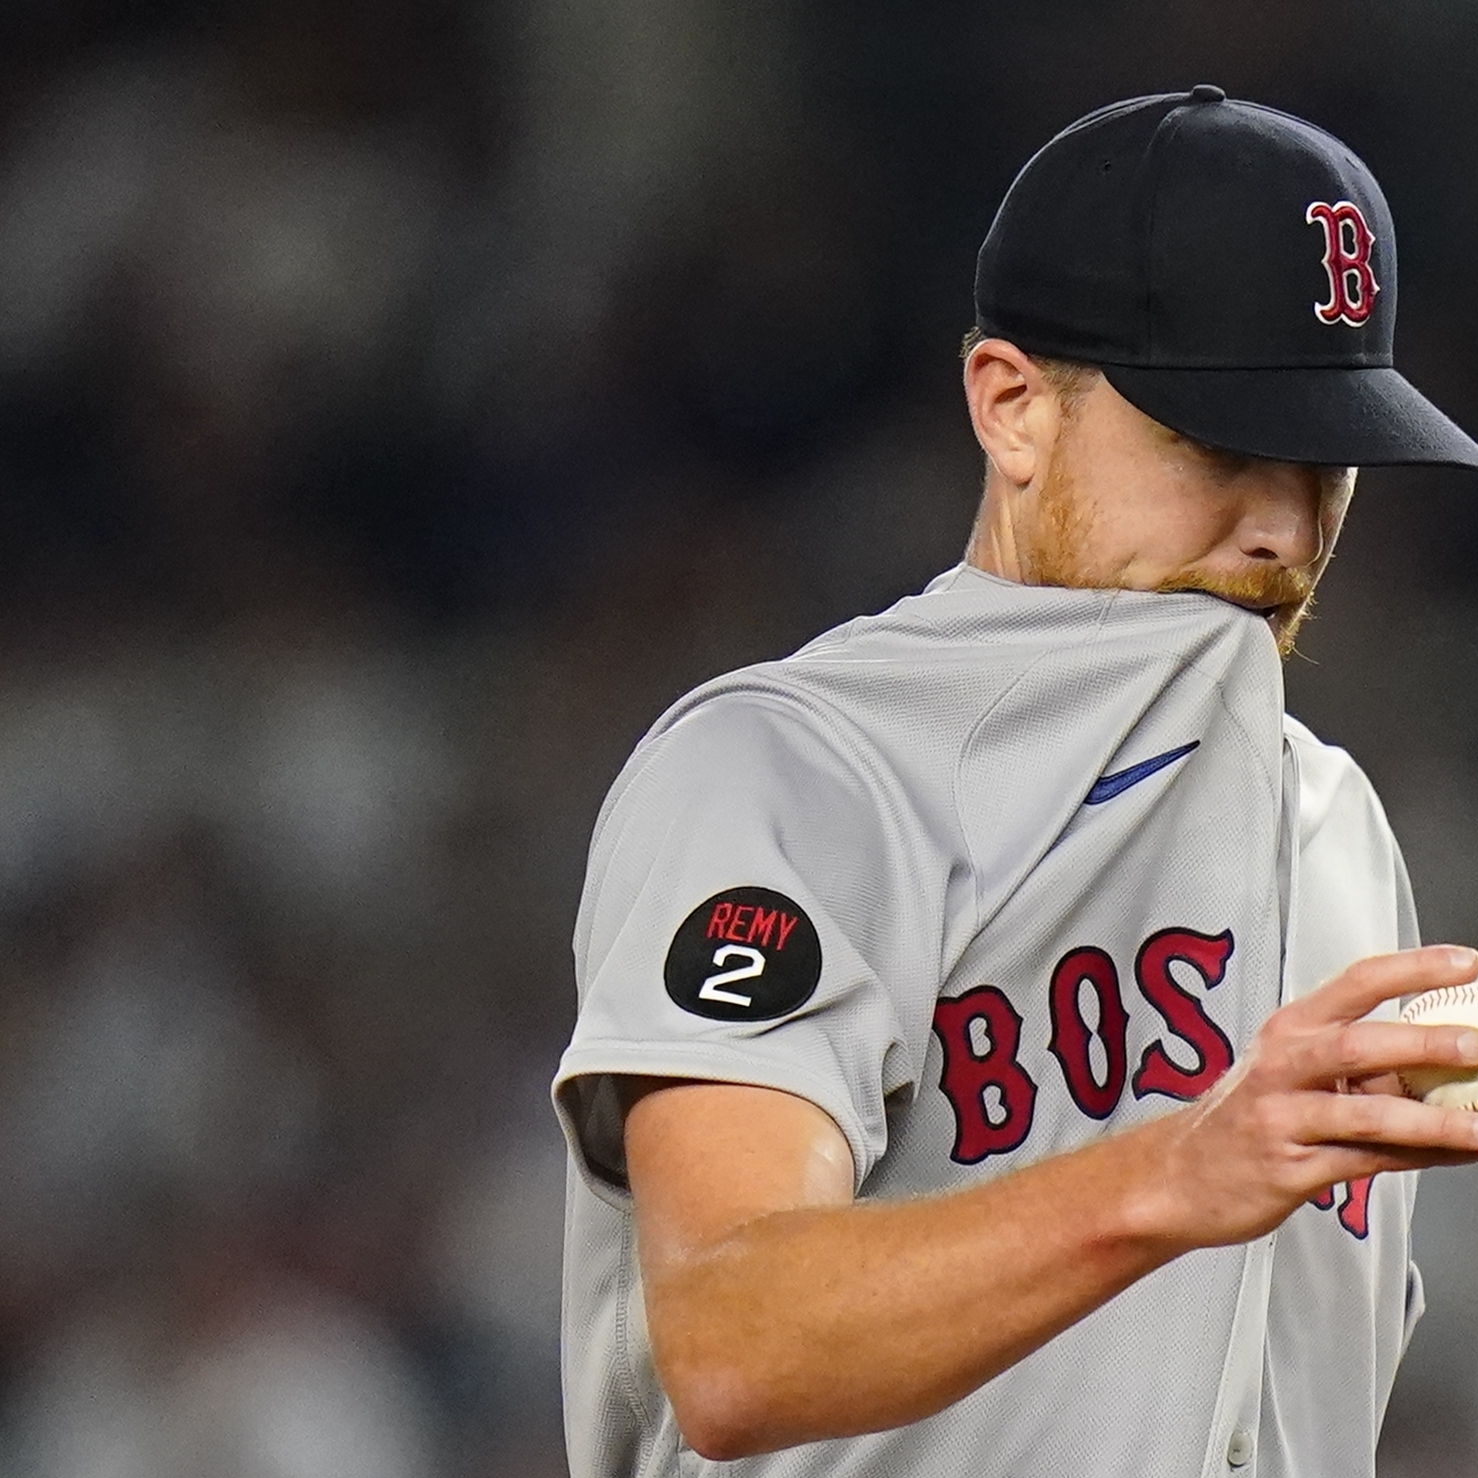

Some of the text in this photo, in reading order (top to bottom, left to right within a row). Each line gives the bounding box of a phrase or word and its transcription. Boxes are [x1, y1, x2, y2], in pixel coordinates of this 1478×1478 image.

[1305, 201, 1380, 328] B
[706, 902, 799, 950] REMY
[699, 944, 766, 1007] 2
